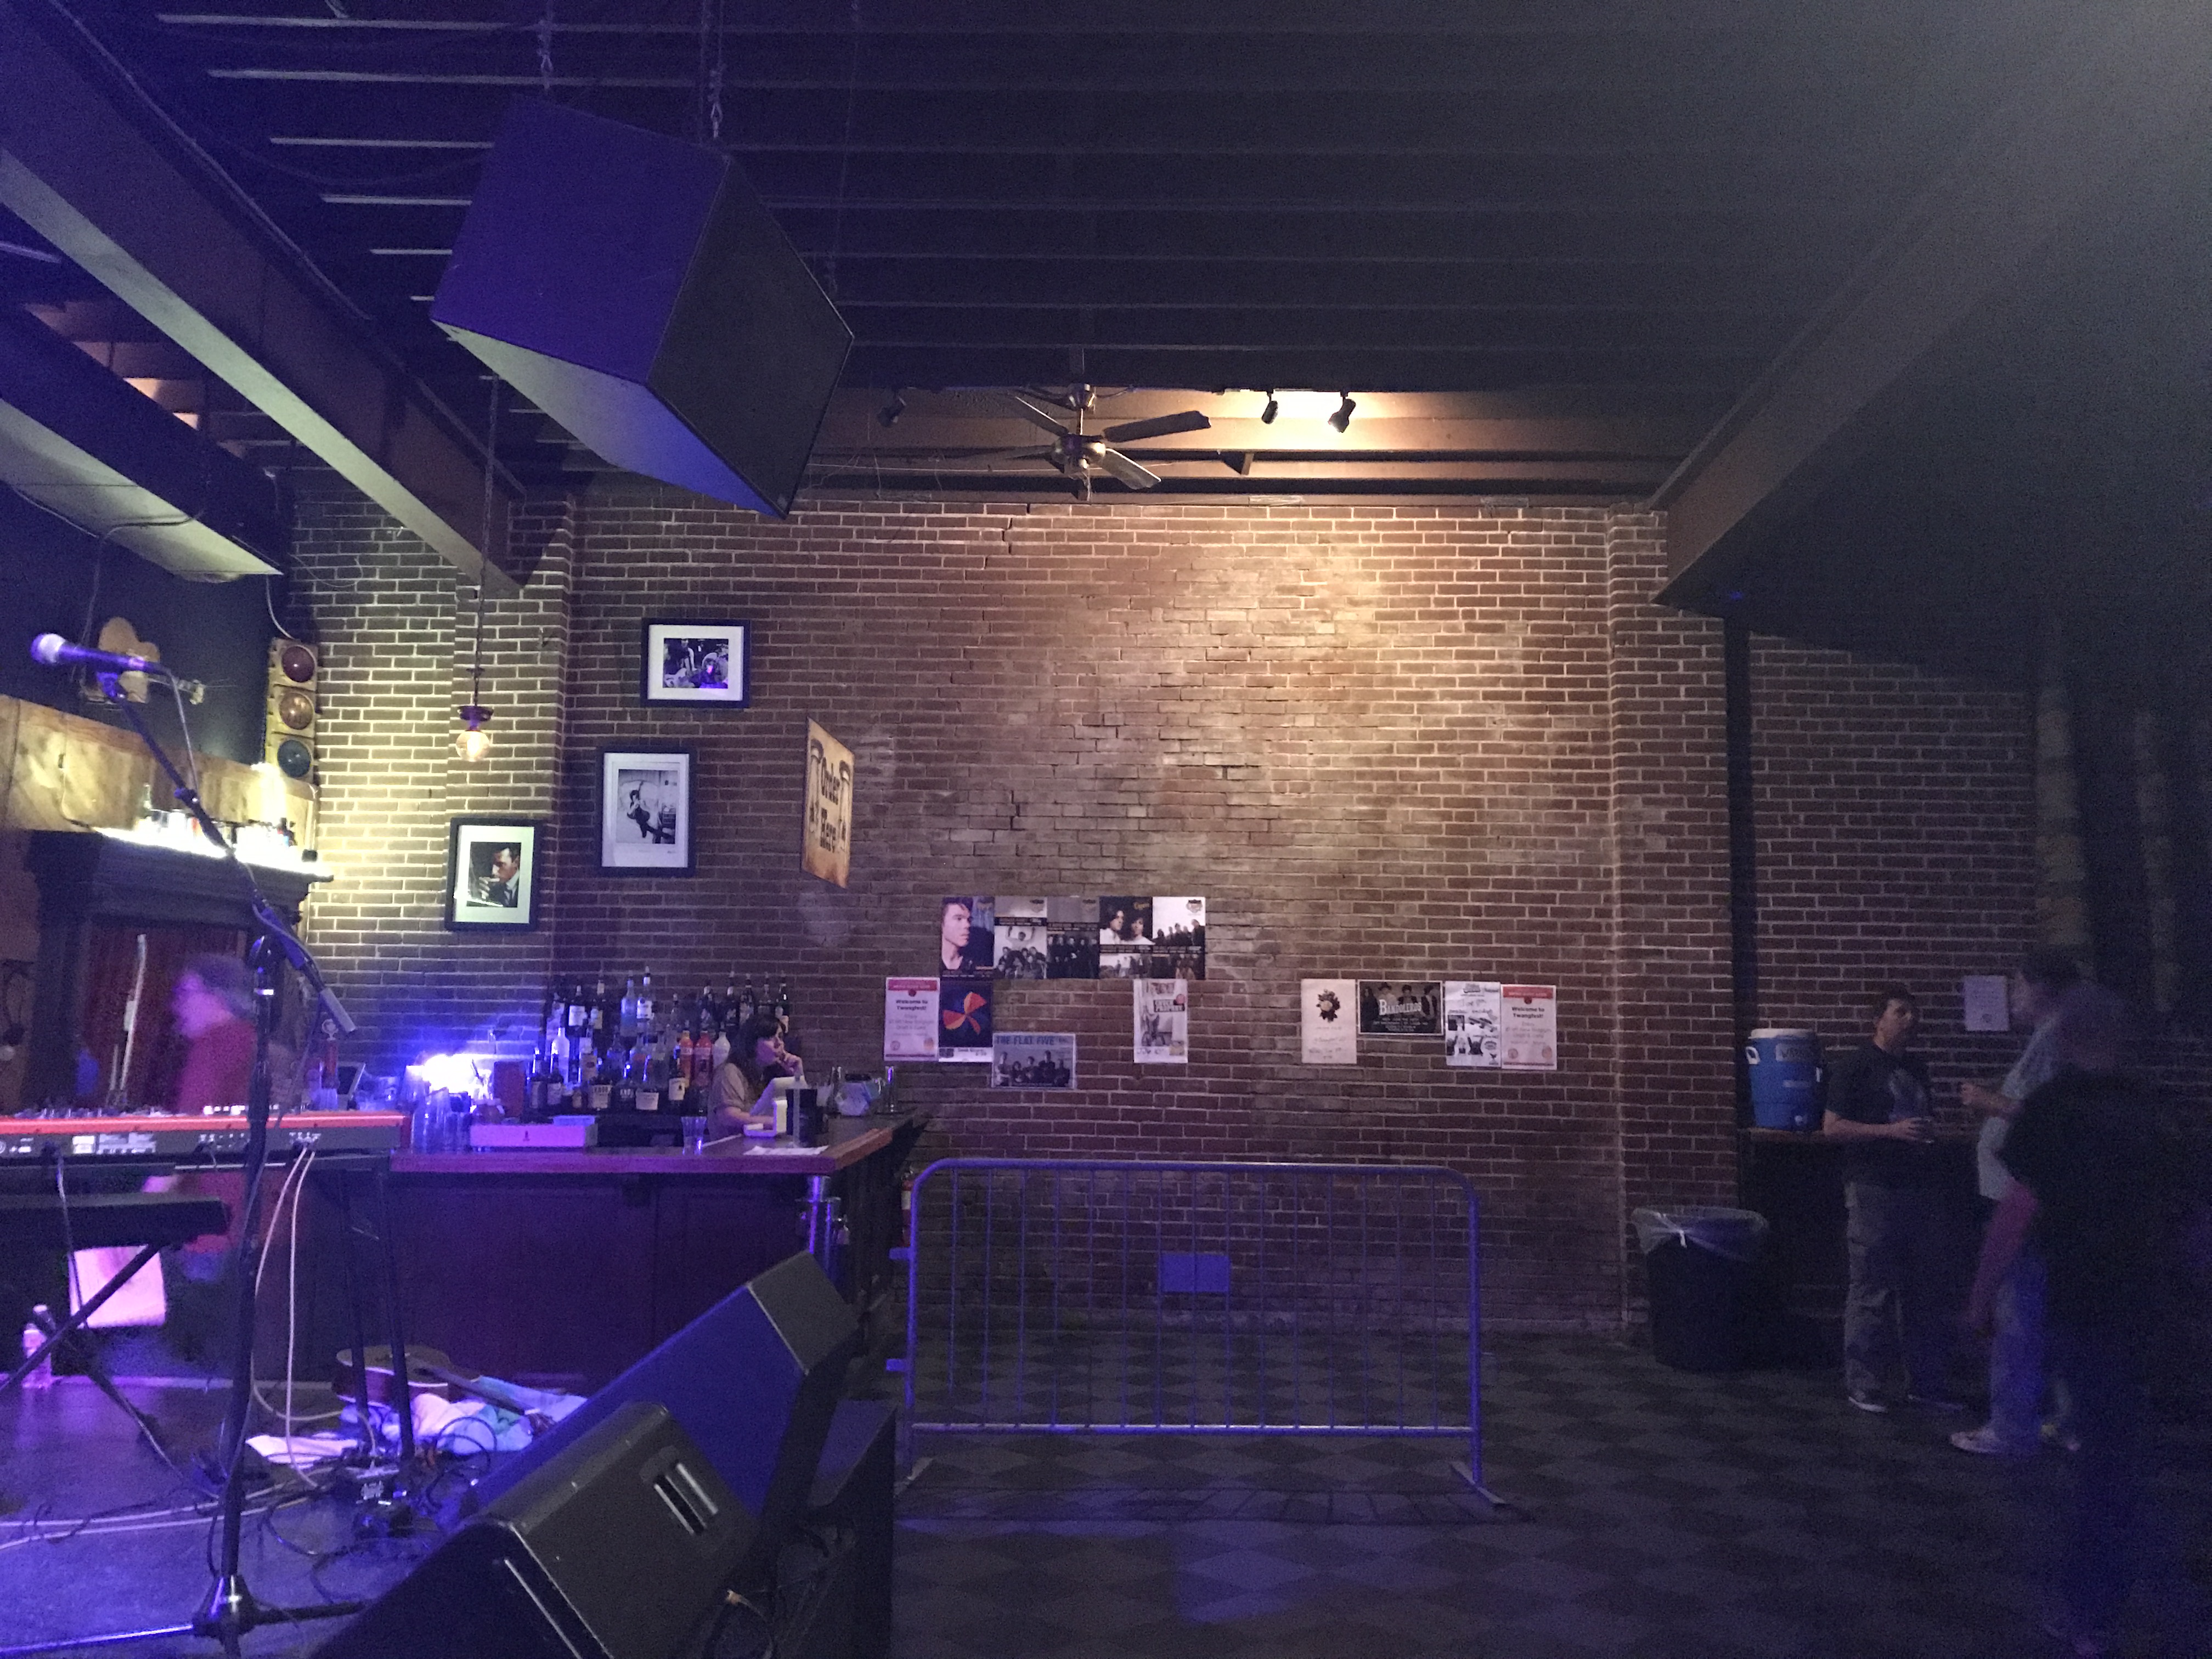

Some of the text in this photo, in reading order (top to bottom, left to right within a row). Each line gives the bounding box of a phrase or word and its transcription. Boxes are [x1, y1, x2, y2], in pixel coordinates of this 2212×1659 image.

[995, 1035, 1011, 1045] THE
[1013, 1035, 1032, 1045] FLAT
[1036, 1036, 1054, 1045] FIVE
